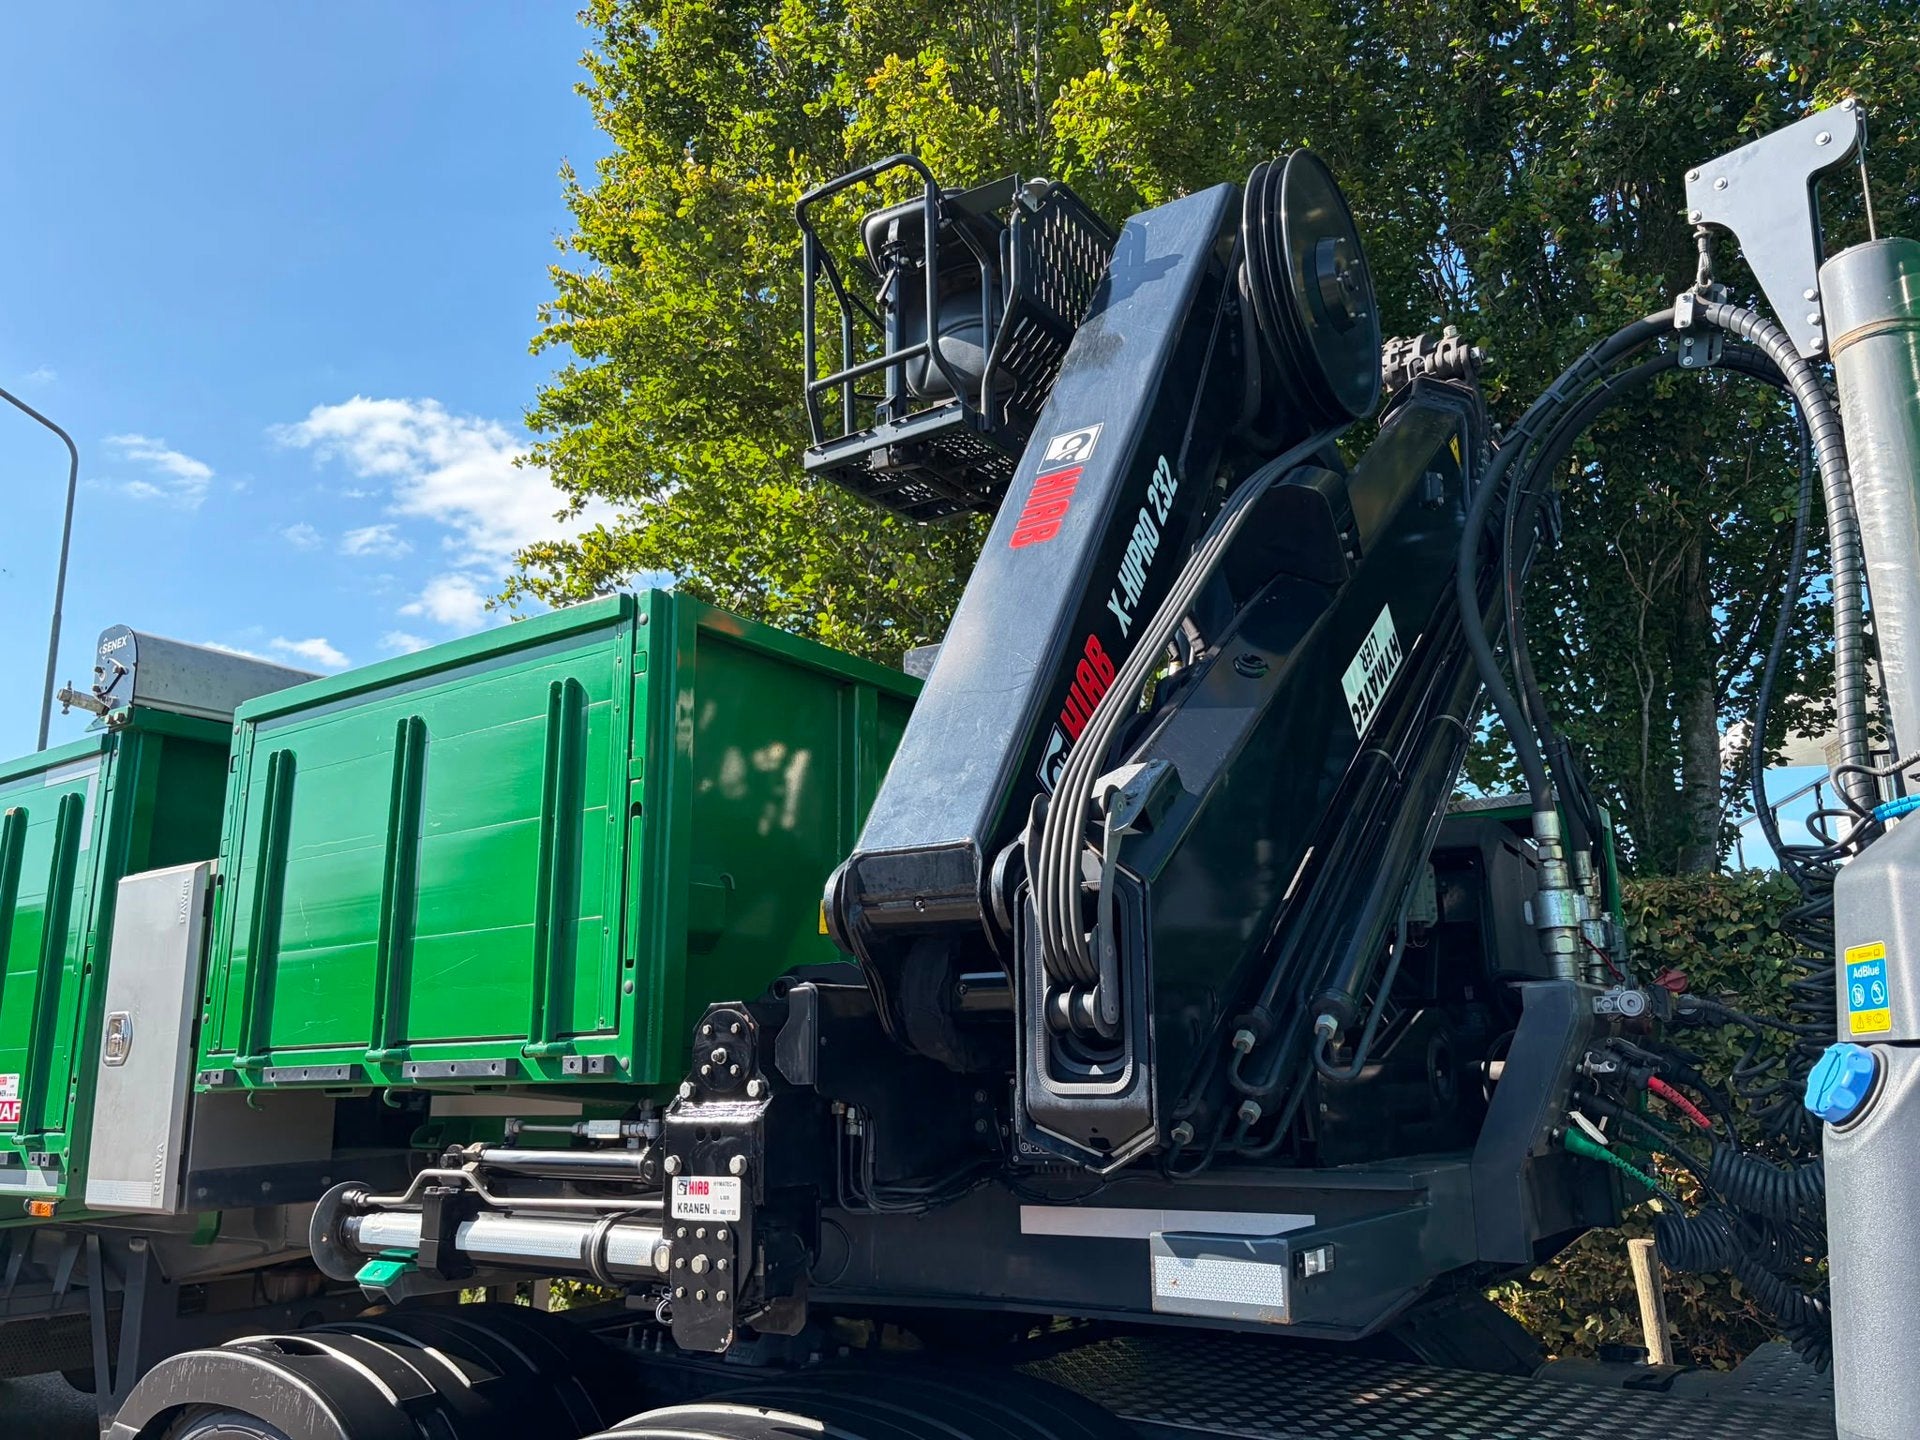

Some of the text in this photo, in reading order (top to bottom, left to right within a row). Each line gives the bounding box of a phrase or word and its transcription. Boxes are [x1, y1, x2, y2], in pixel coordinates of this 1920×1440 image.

[1009, 466, 1084, 549] HIAB
[1107, 454, 1178, 639] X-HIPRO 232
[102, 635, 127, 654] SENEX
[1360, 632, 1379, 673] LIER
[1060, 634, 1115, 741] HIAB
[1351, 632, 1401, 732] HYMATEC
[1853, 964, 1880, 979] AdBlue
[0, 1102, 21, 1121] AF
[688, 1181, 709, 1196] HIAB
[677, 1202, 711, 1214] KRANEN
